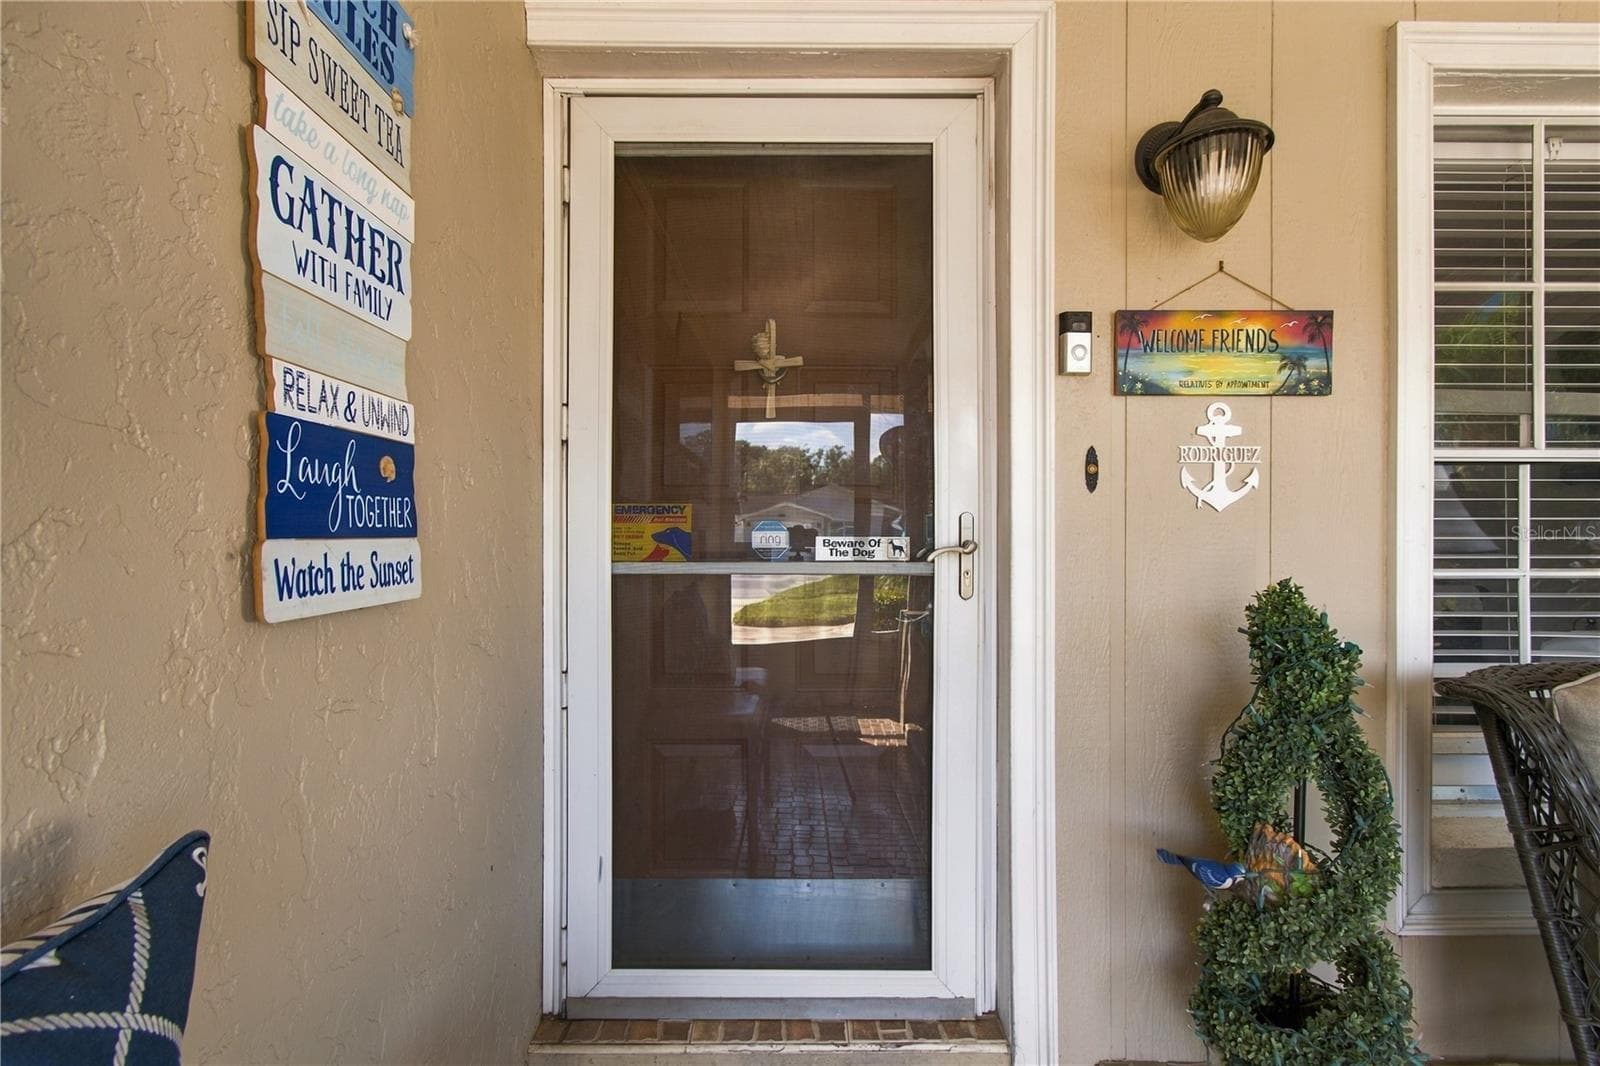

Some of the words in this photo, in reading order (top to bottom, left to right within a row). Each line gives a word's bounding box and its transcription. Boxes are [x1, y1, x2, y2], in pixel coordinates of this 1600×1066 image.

[267, 0, 301, 66] SIP
[308, 37, 370, 134] SWEET
[374, 104, 405, 168] TEA
[273, 92, 320, 150] take
[324, 141, 338, 165] a
[342, 149, 378, 206] long
[380, 188, 409, 225] nap
[269, 154, 405, 296] GATHER
[292, 240, 337, 293] WITH
[345, 271, 393, 322] FAMILY
[1138, 328, 1205, 353] WELCOME
[1211, 328, 1280, 354] FRIENDS
[283, 366, 340, 420] RELAX
[343, 390, 357, 424] &
[361, 391, 410, 437] UNWIND
[1178, 379, 1213, 389] RELATIVES
[1215, 379, 1224, 389] BY
[1178, 445, 1263, 464] RODRIGUEZ
[275, 420, 361, 533] Laugh
[346, 494, 413, 529] TOGETHER
[614, 504, 687, 515] EMERGENCY
[822, 538, 866, 549] Beware
[867, 538, 882, 549] Of
[828, 549, 849, 558] The
[852, 549, 876, 559] Dog
[274, 551, 335, 602] Watch
[341, 550, 365, 593] the
[369, 550, 414, 589] Sunset
